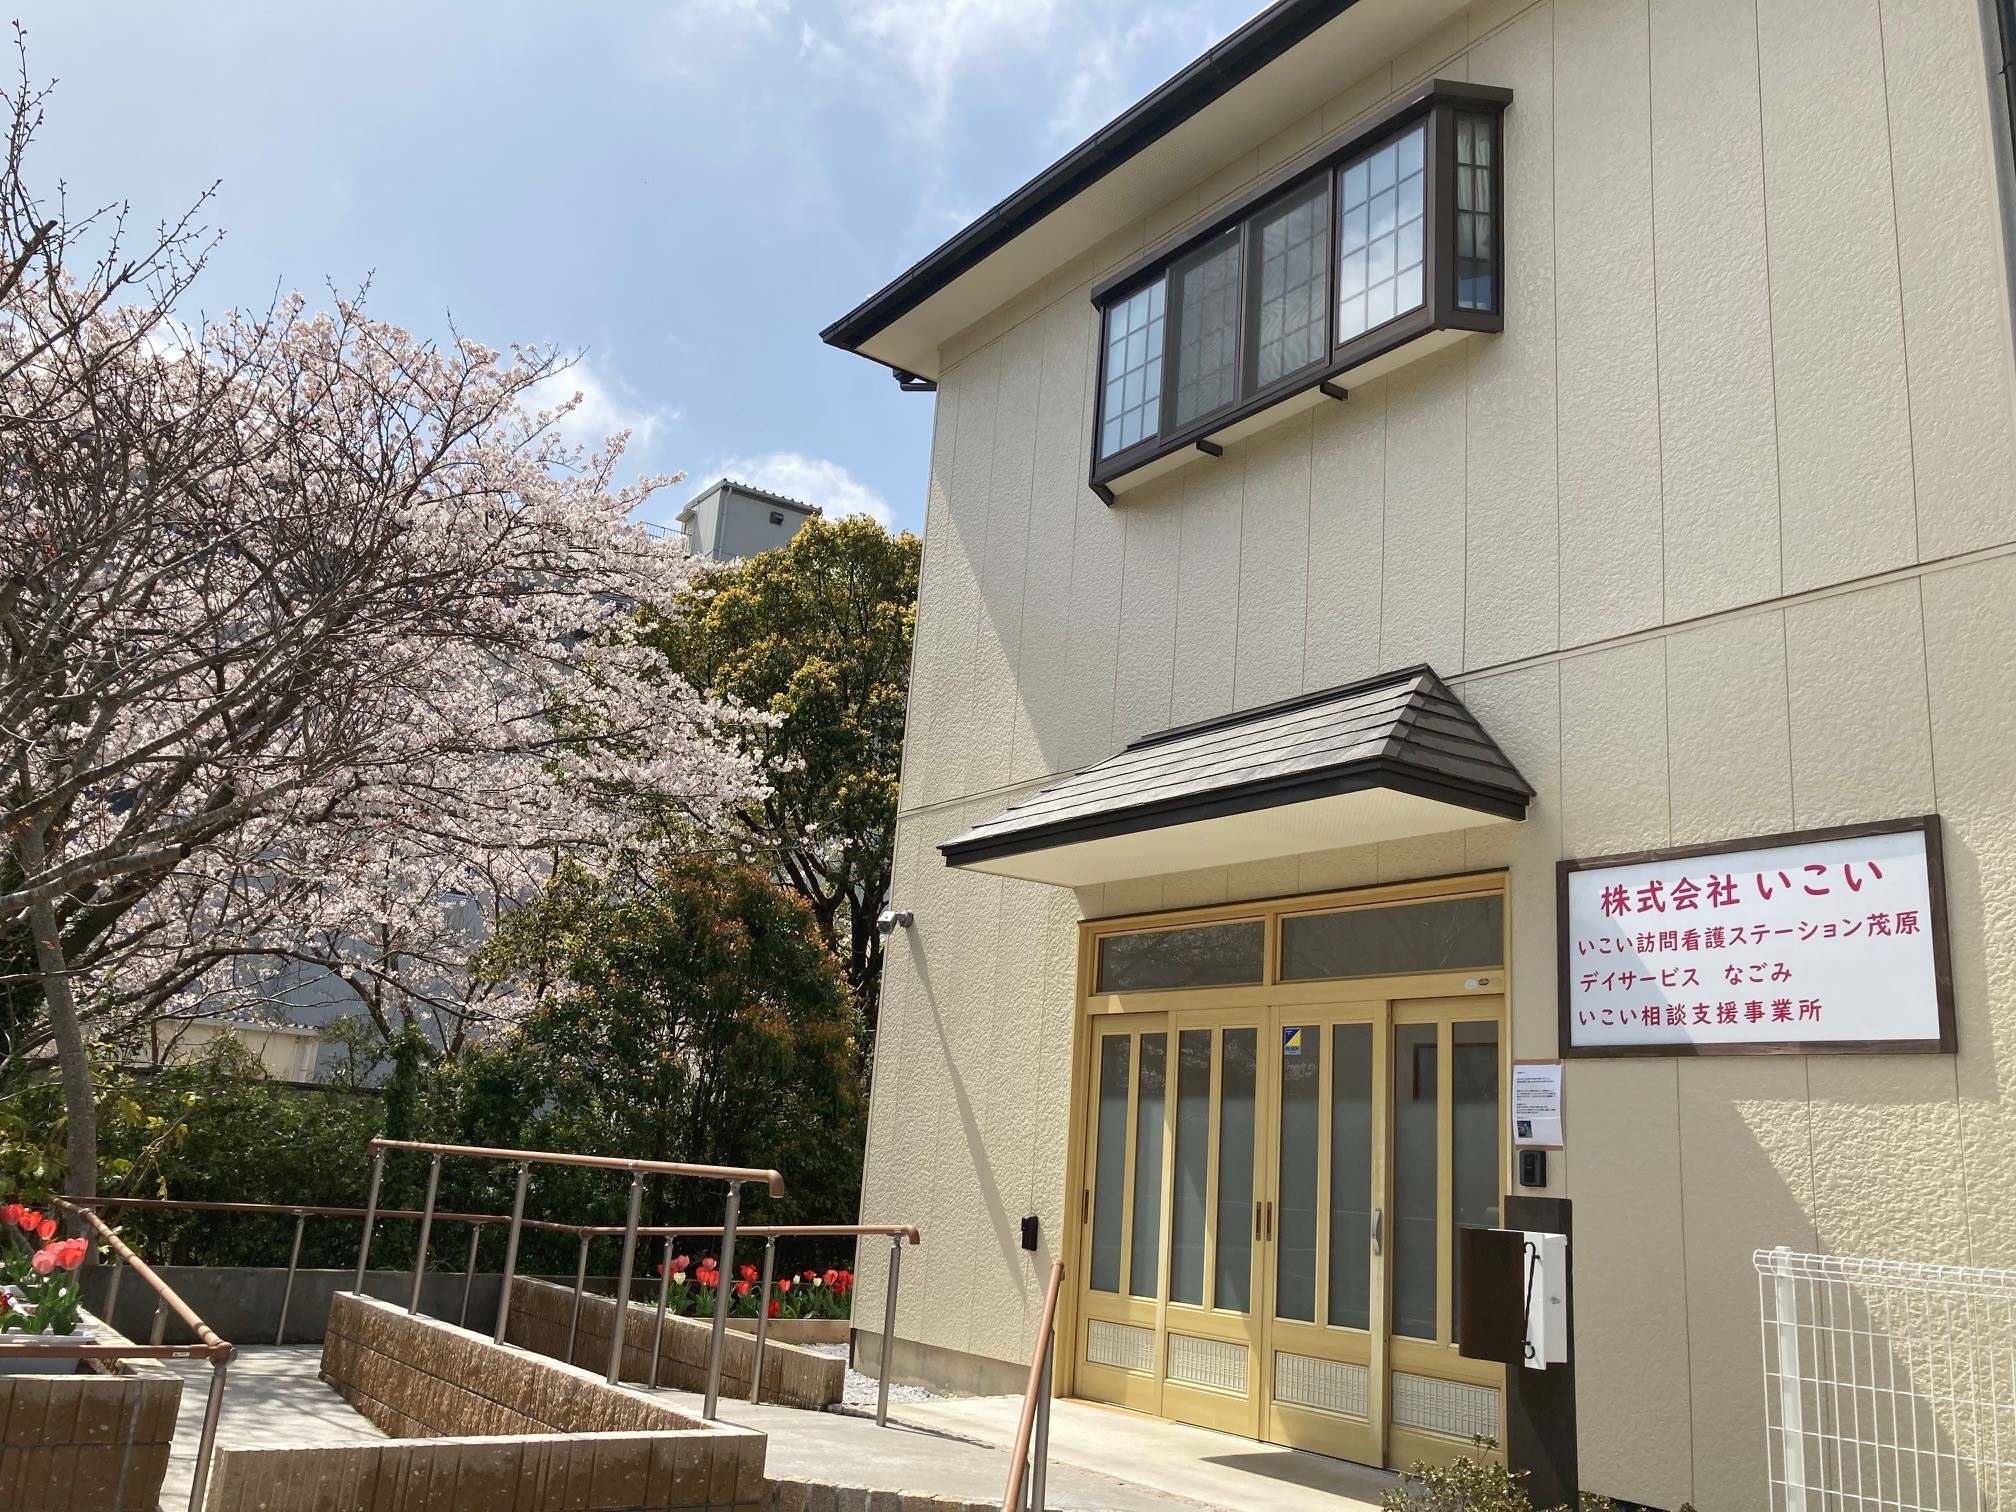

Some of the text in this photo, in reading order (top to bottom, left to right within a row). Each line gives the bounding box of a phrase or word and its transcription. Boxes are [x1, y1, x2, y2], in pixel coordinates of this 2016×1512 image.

[1601, 862, 1884, 918] 株式会社 いこい
[1578, 910, 1921, 956] いこい訪問看護ステーション茂原
[1580, 962, 1793, 993] デイサービス なごみ
[1578, 998, 1823, 1026] いこい相談支援事業所
